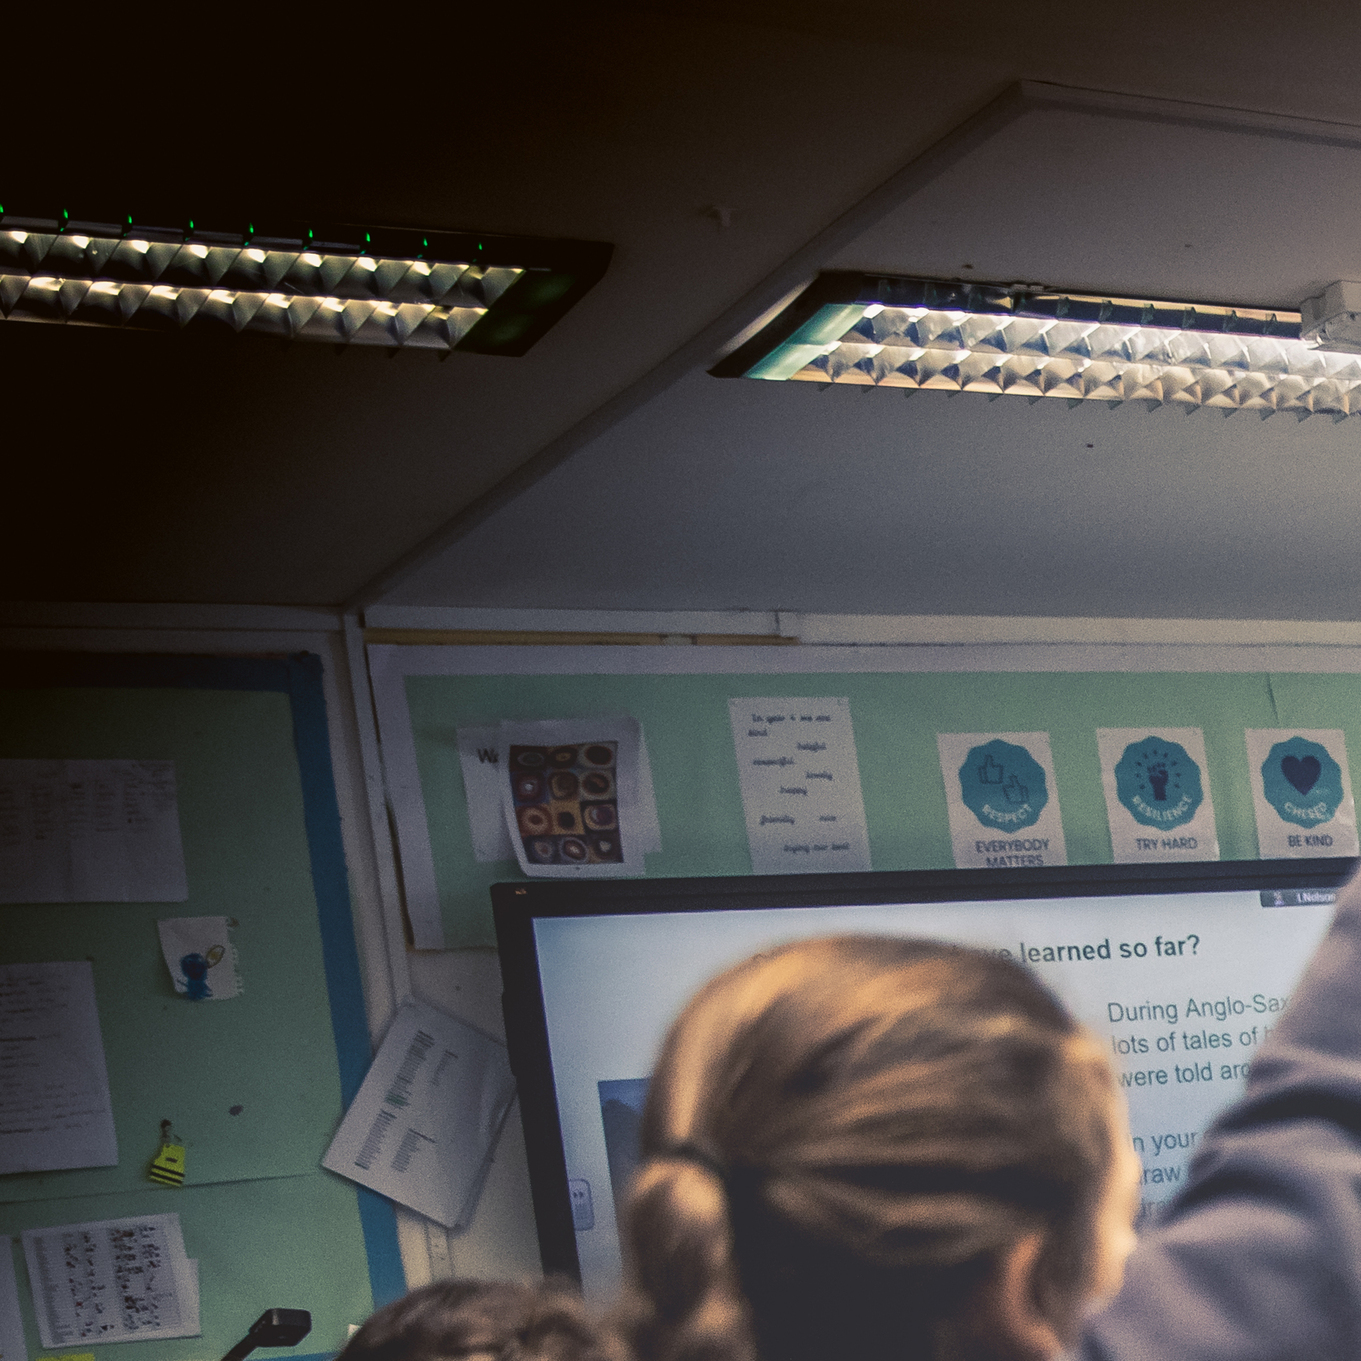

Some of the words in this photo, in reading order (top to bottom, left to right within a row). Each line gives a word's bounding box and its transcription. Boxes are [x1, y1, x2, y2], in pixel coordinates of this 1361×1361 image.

[981, 803, 1034, 825] RESPECT
[1131, 795, 1193, 822] RESILIENCE
[975, 838, 1049, 854] EVERYBODY
[1135, 838, 1159, 851] TRY
[1162, 837, 1198, 850] HARD
[1287, 835, 1302, 848] BE
[1304, 834, 1333, 848] KIND
[986, 854, 1044, 867] MATTERS
[1019, 940, 1111, 964] learned
[1118, 941, 1148, 959] so
[1154, 934, 1201, 957] far?
[1108, 1000, 1178, 1024] During
[1112, 1033, 1149, 1055] lots
[1156, 1033, 1176, 1052] of
[1182, 1029, 1233, 1051] tales
[1238, 1028, 1259, 1047] of
[1120, 1065, 1169, 1088] were
[1175, 1062, 1213, 1084] told
